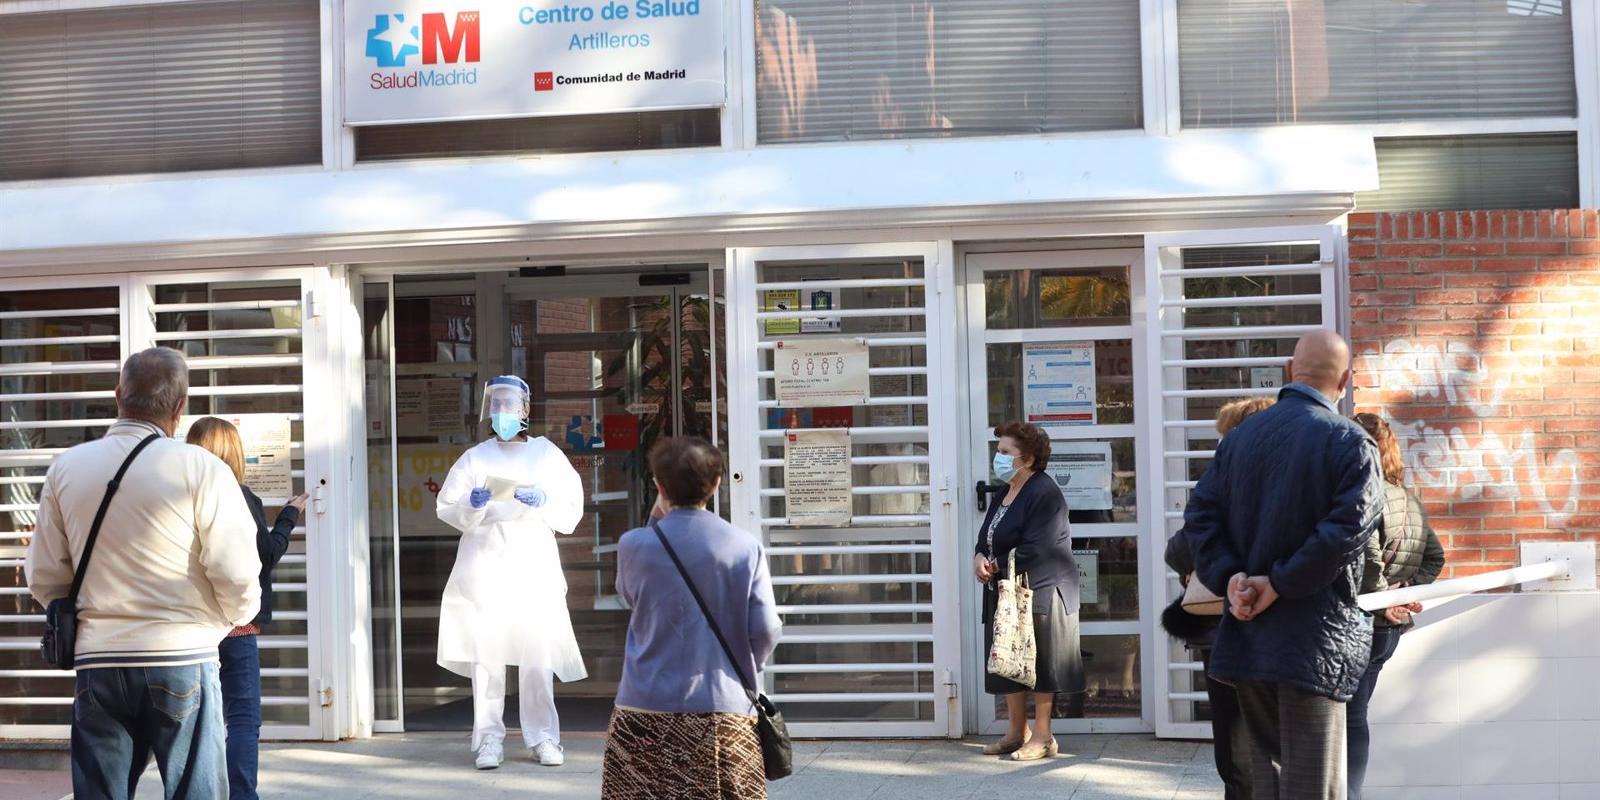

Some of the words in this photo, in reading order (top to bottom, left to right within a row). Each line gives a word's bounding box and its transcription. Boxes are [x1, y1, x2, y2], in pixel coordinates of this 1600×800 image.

[518, 4, 594, 25] Centro
[600, 3, 629, 22] de
[635, 0, 700, 19] Salud
[568, 32, 650, 51] Artilleros
[370, 68, 478, 90] SaludMadrid
[556, 73, 624, 85] Comunidad
[626, 72, 642, 82] de
[644, 69, 686, 80] Madrid
